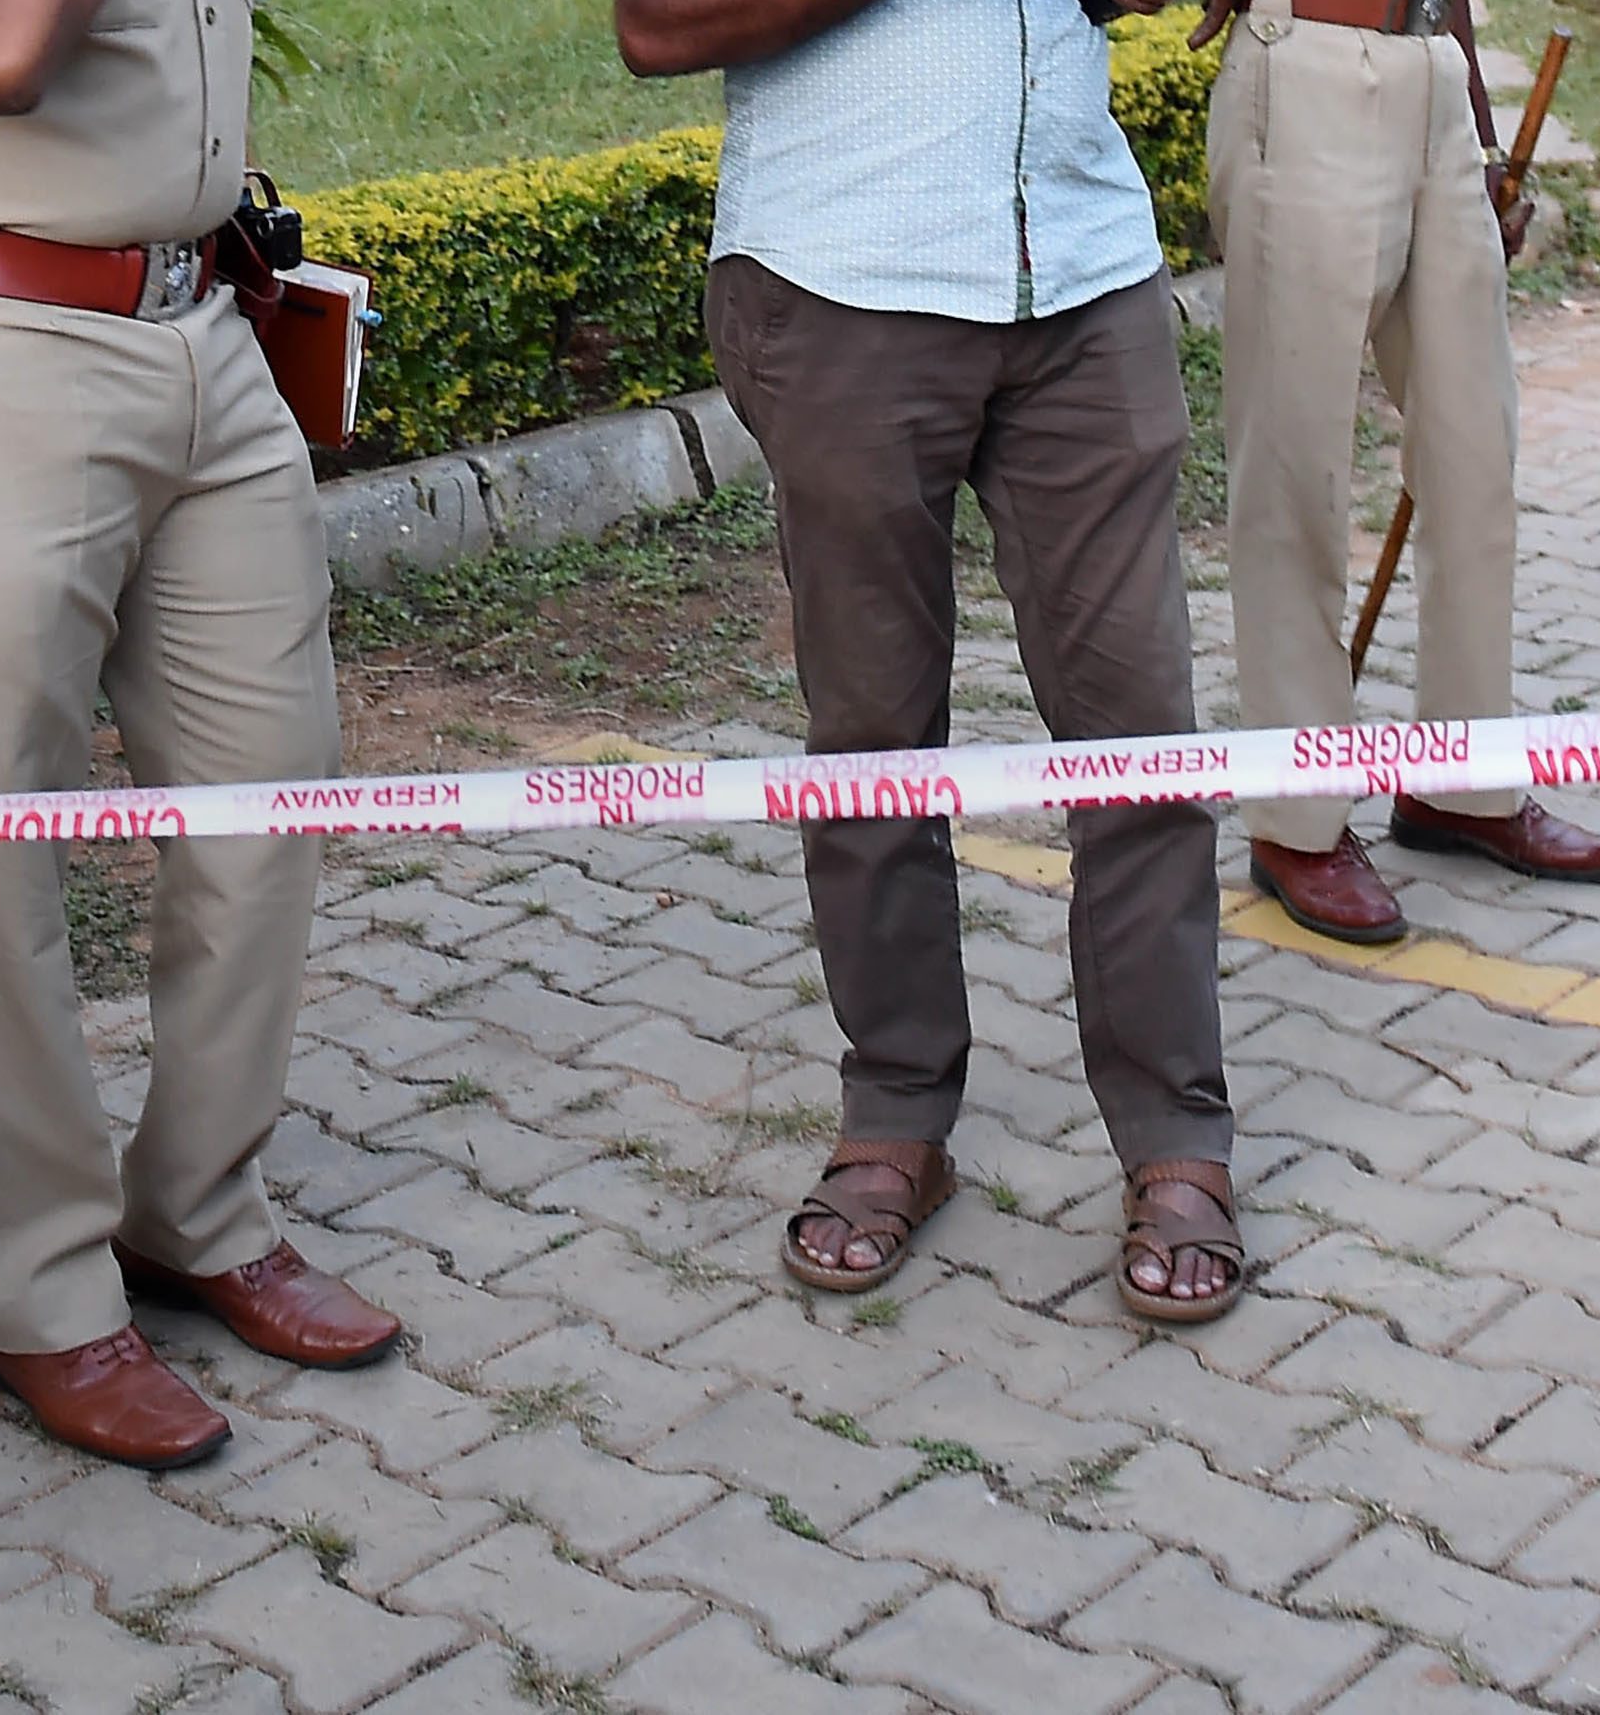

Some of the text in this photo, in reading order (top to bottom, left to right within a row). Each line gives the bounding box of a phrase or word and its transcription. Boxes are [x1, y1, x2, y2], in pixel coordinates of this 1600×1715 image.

[1294, 724, 1470, 770] PROGRESS
[1042, 750, 1227, 779] KEEP AWAY
[272, 789, 362, 808] AWAY
[526, 767, 705, 806] PROGRESS
